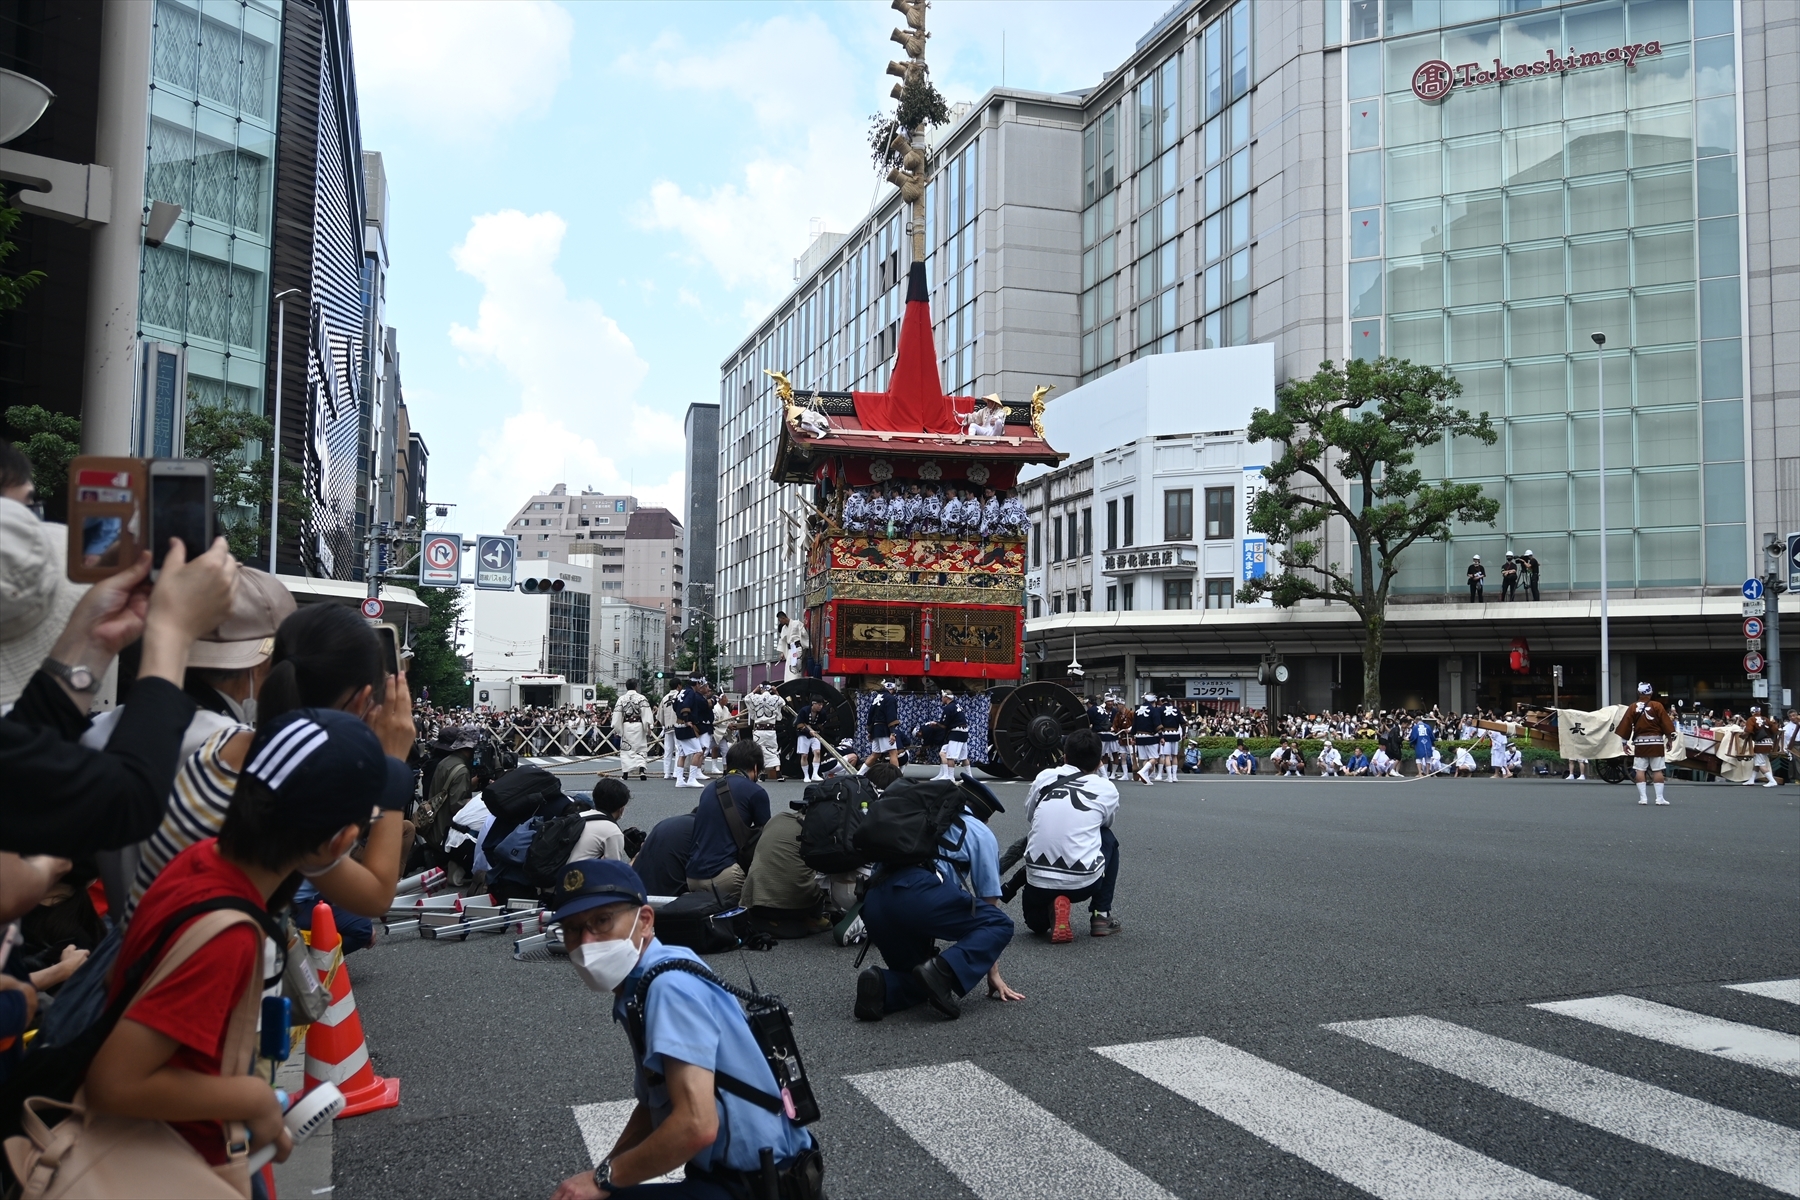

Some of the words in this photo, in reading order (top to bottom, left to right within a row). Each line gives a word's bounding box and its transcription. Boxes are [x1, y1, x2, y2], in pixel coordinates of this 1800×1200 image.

[1456, 40, 1662, 87] Takashimaya
[1246, 486, 1255, 534] コンタト
[1245, 543, 1254, 579] 買えます
[1253, 543, 1263, 562] すぐ
[1193, 687, 1233, 696] コンタクト
